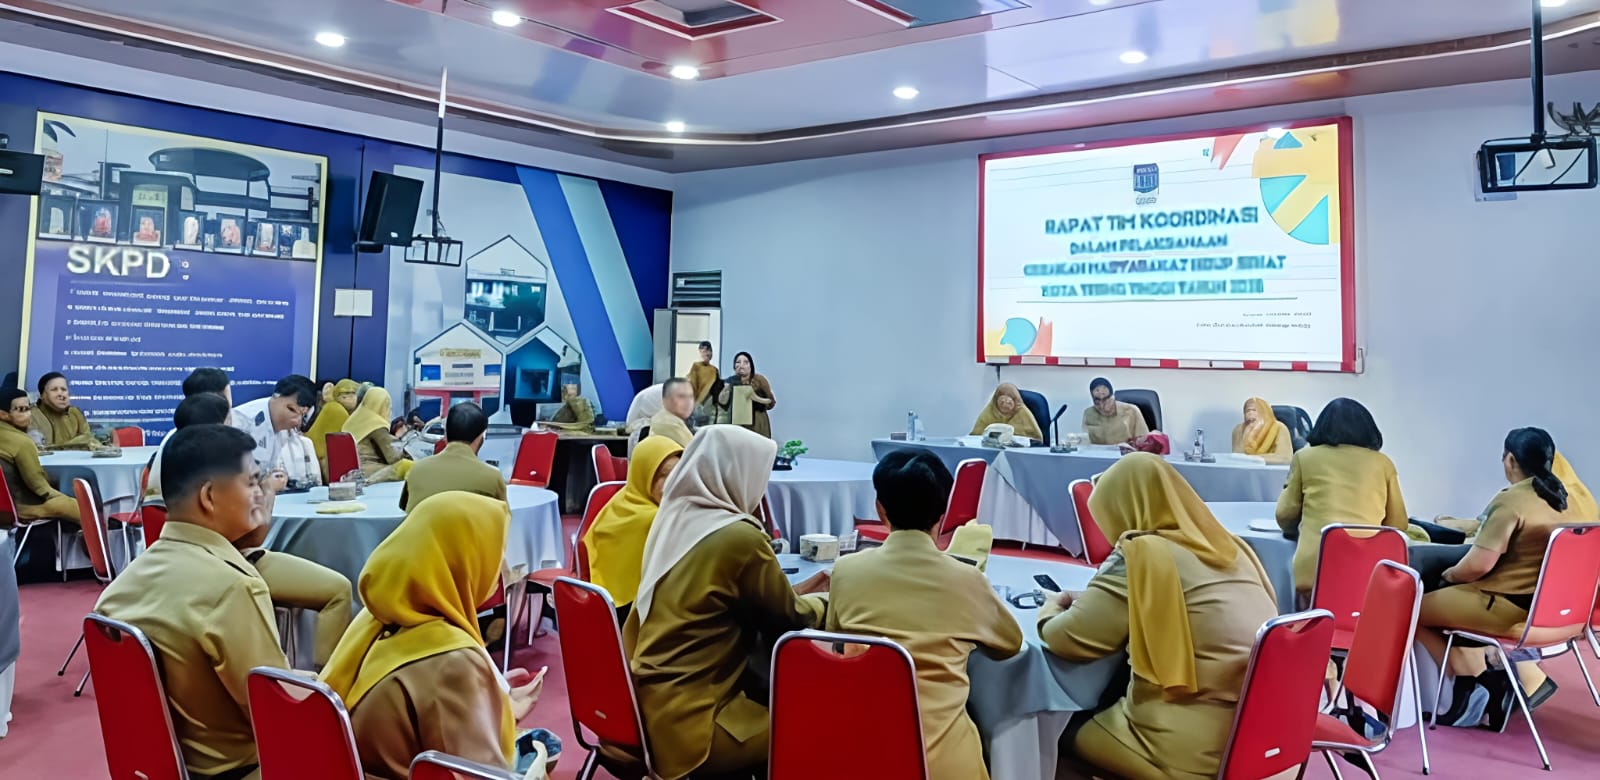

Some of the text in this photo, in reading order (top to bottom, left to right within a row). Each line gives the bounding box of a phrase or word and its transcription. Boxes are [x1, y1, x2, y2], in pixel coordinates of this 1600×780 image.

[1045, 206, 1258, 234] RAPAT TIM KOORDINASI
[1070, 241, 1117, 254] DALAM
[67, 246, 171, 279] SKPD
